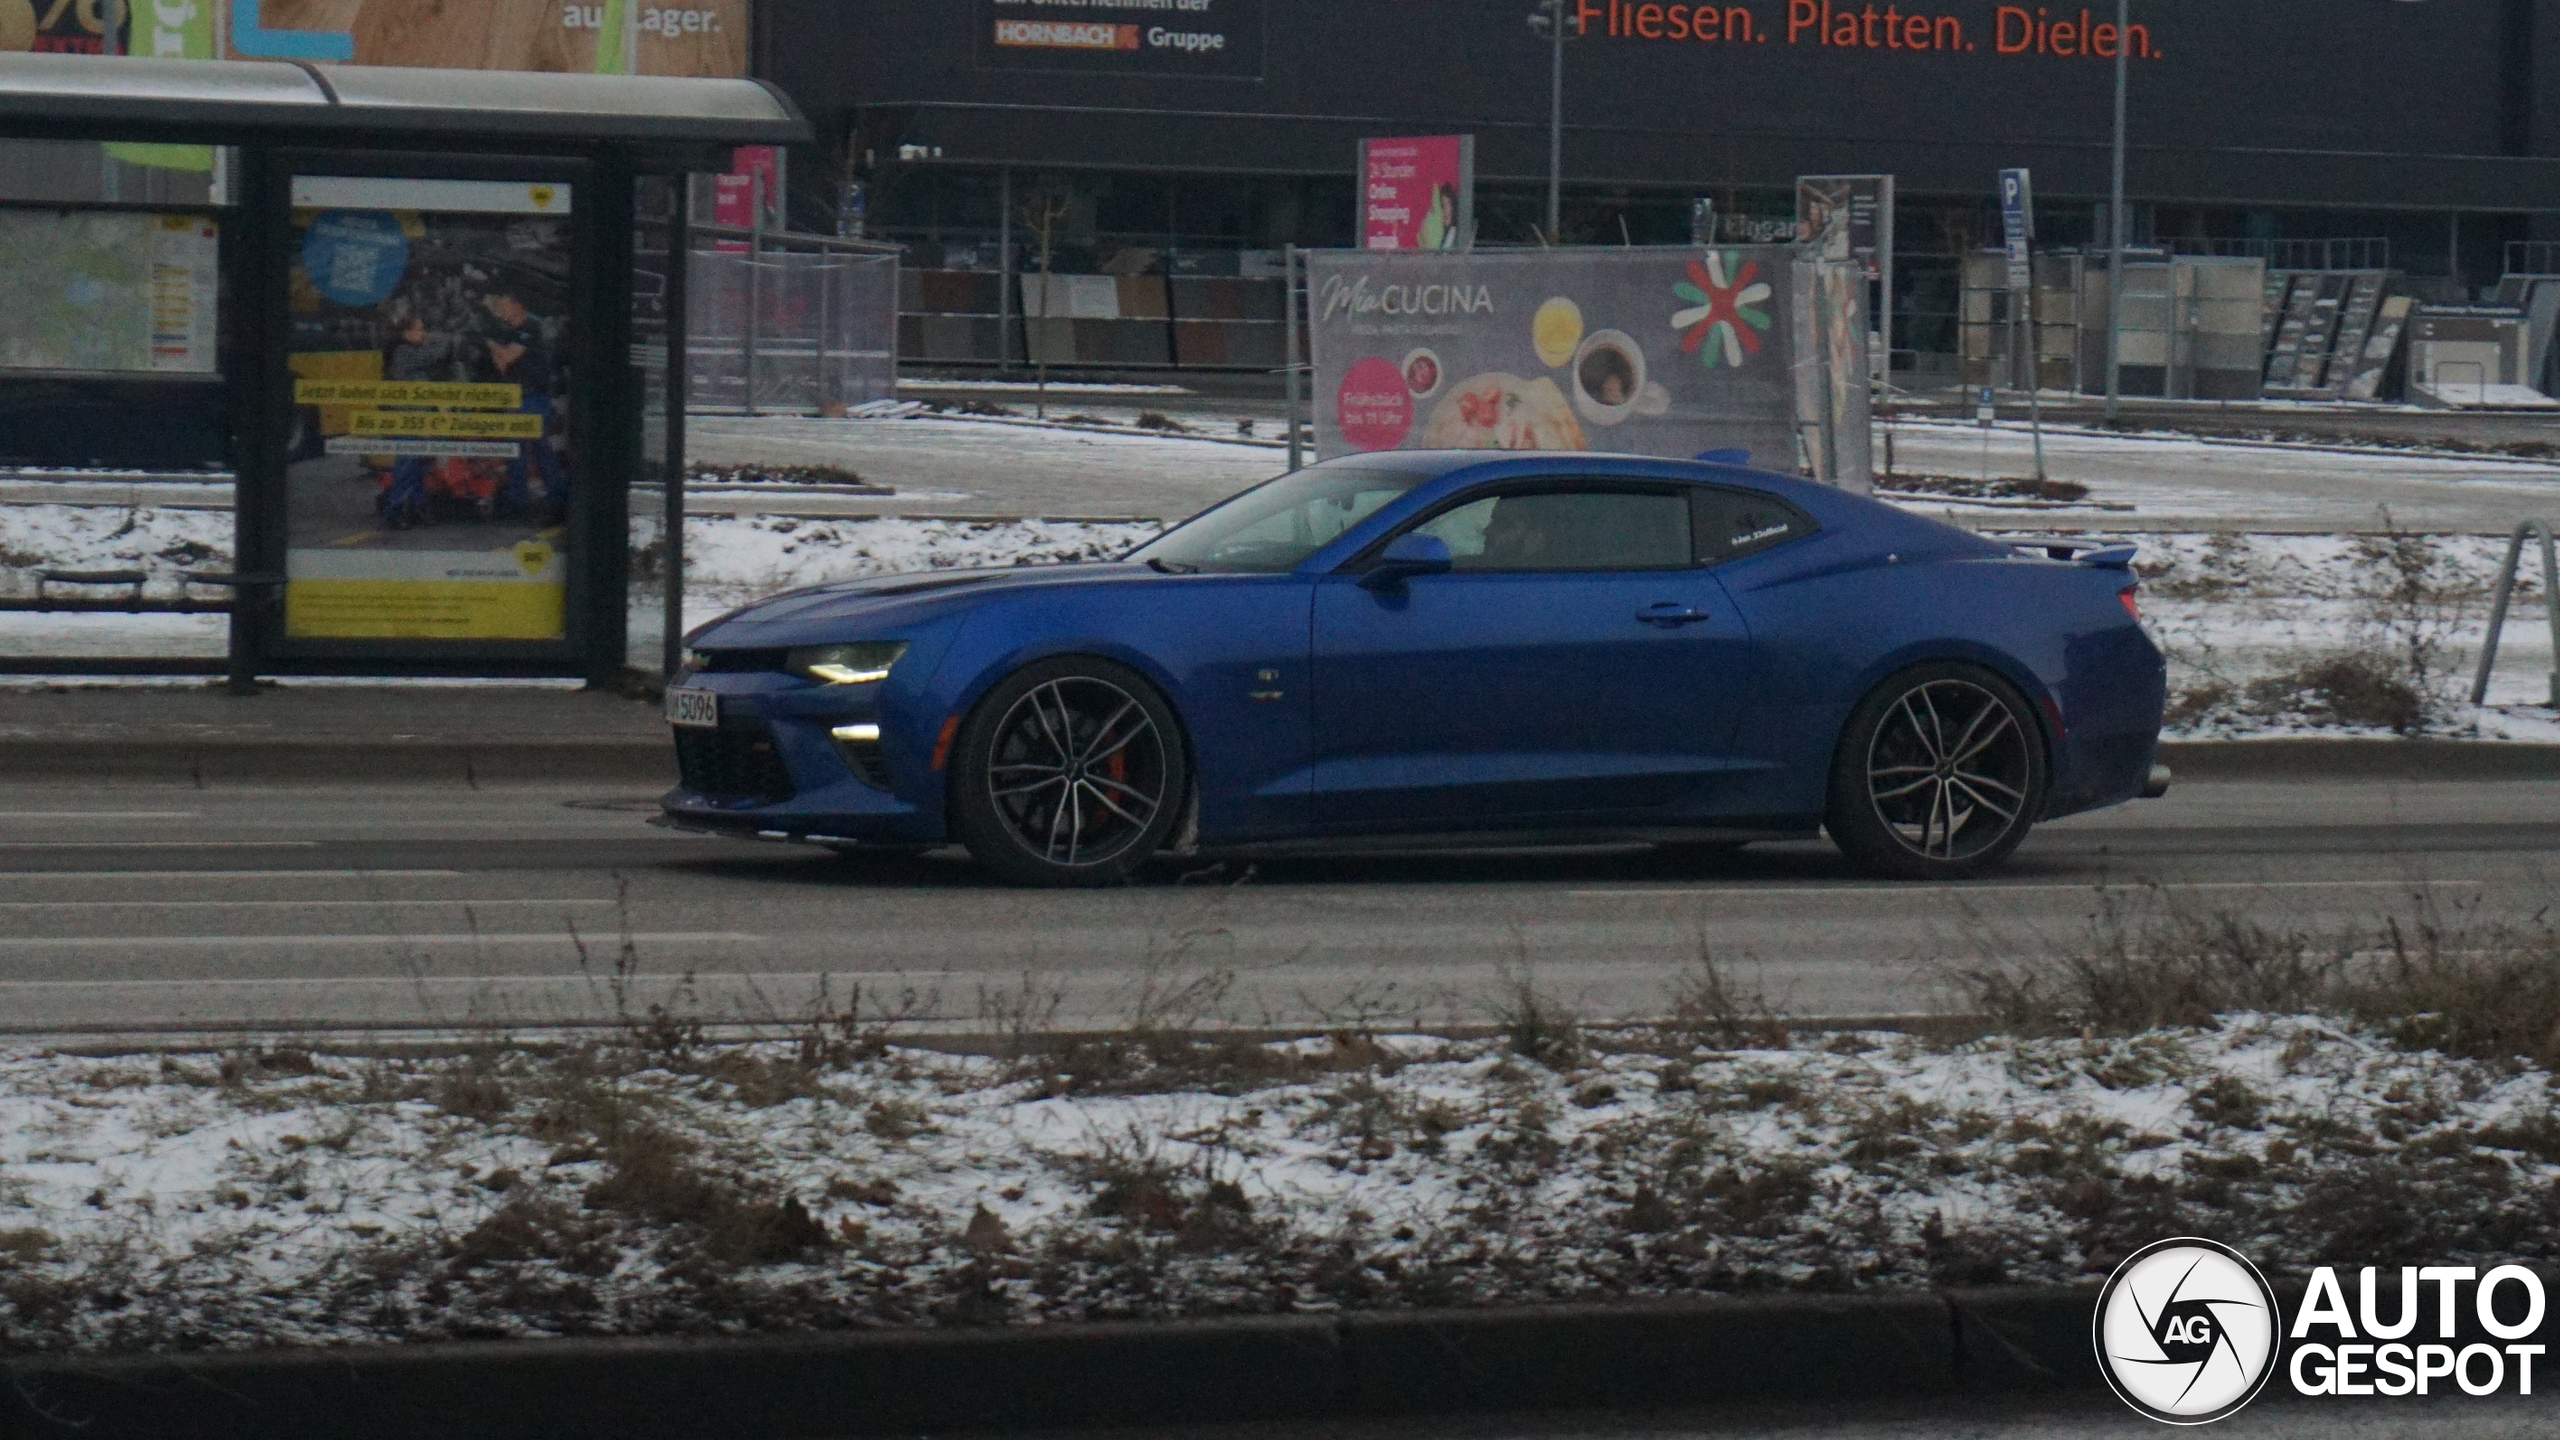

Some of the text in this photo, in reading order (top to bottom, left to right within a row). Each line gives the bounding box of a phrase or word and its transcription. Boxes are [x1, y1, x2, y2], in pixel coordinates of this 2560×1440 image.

[563, 5, 722, 37] au ager.
[1577, 0, 2163, 59] Fliesen. Platten. Dielen.
[995, 22, 1224, 51] HORNBACH Gruppe
[2004, 178, 2019, 205] P
[1381, 285, 1495, 315] CUCINA
